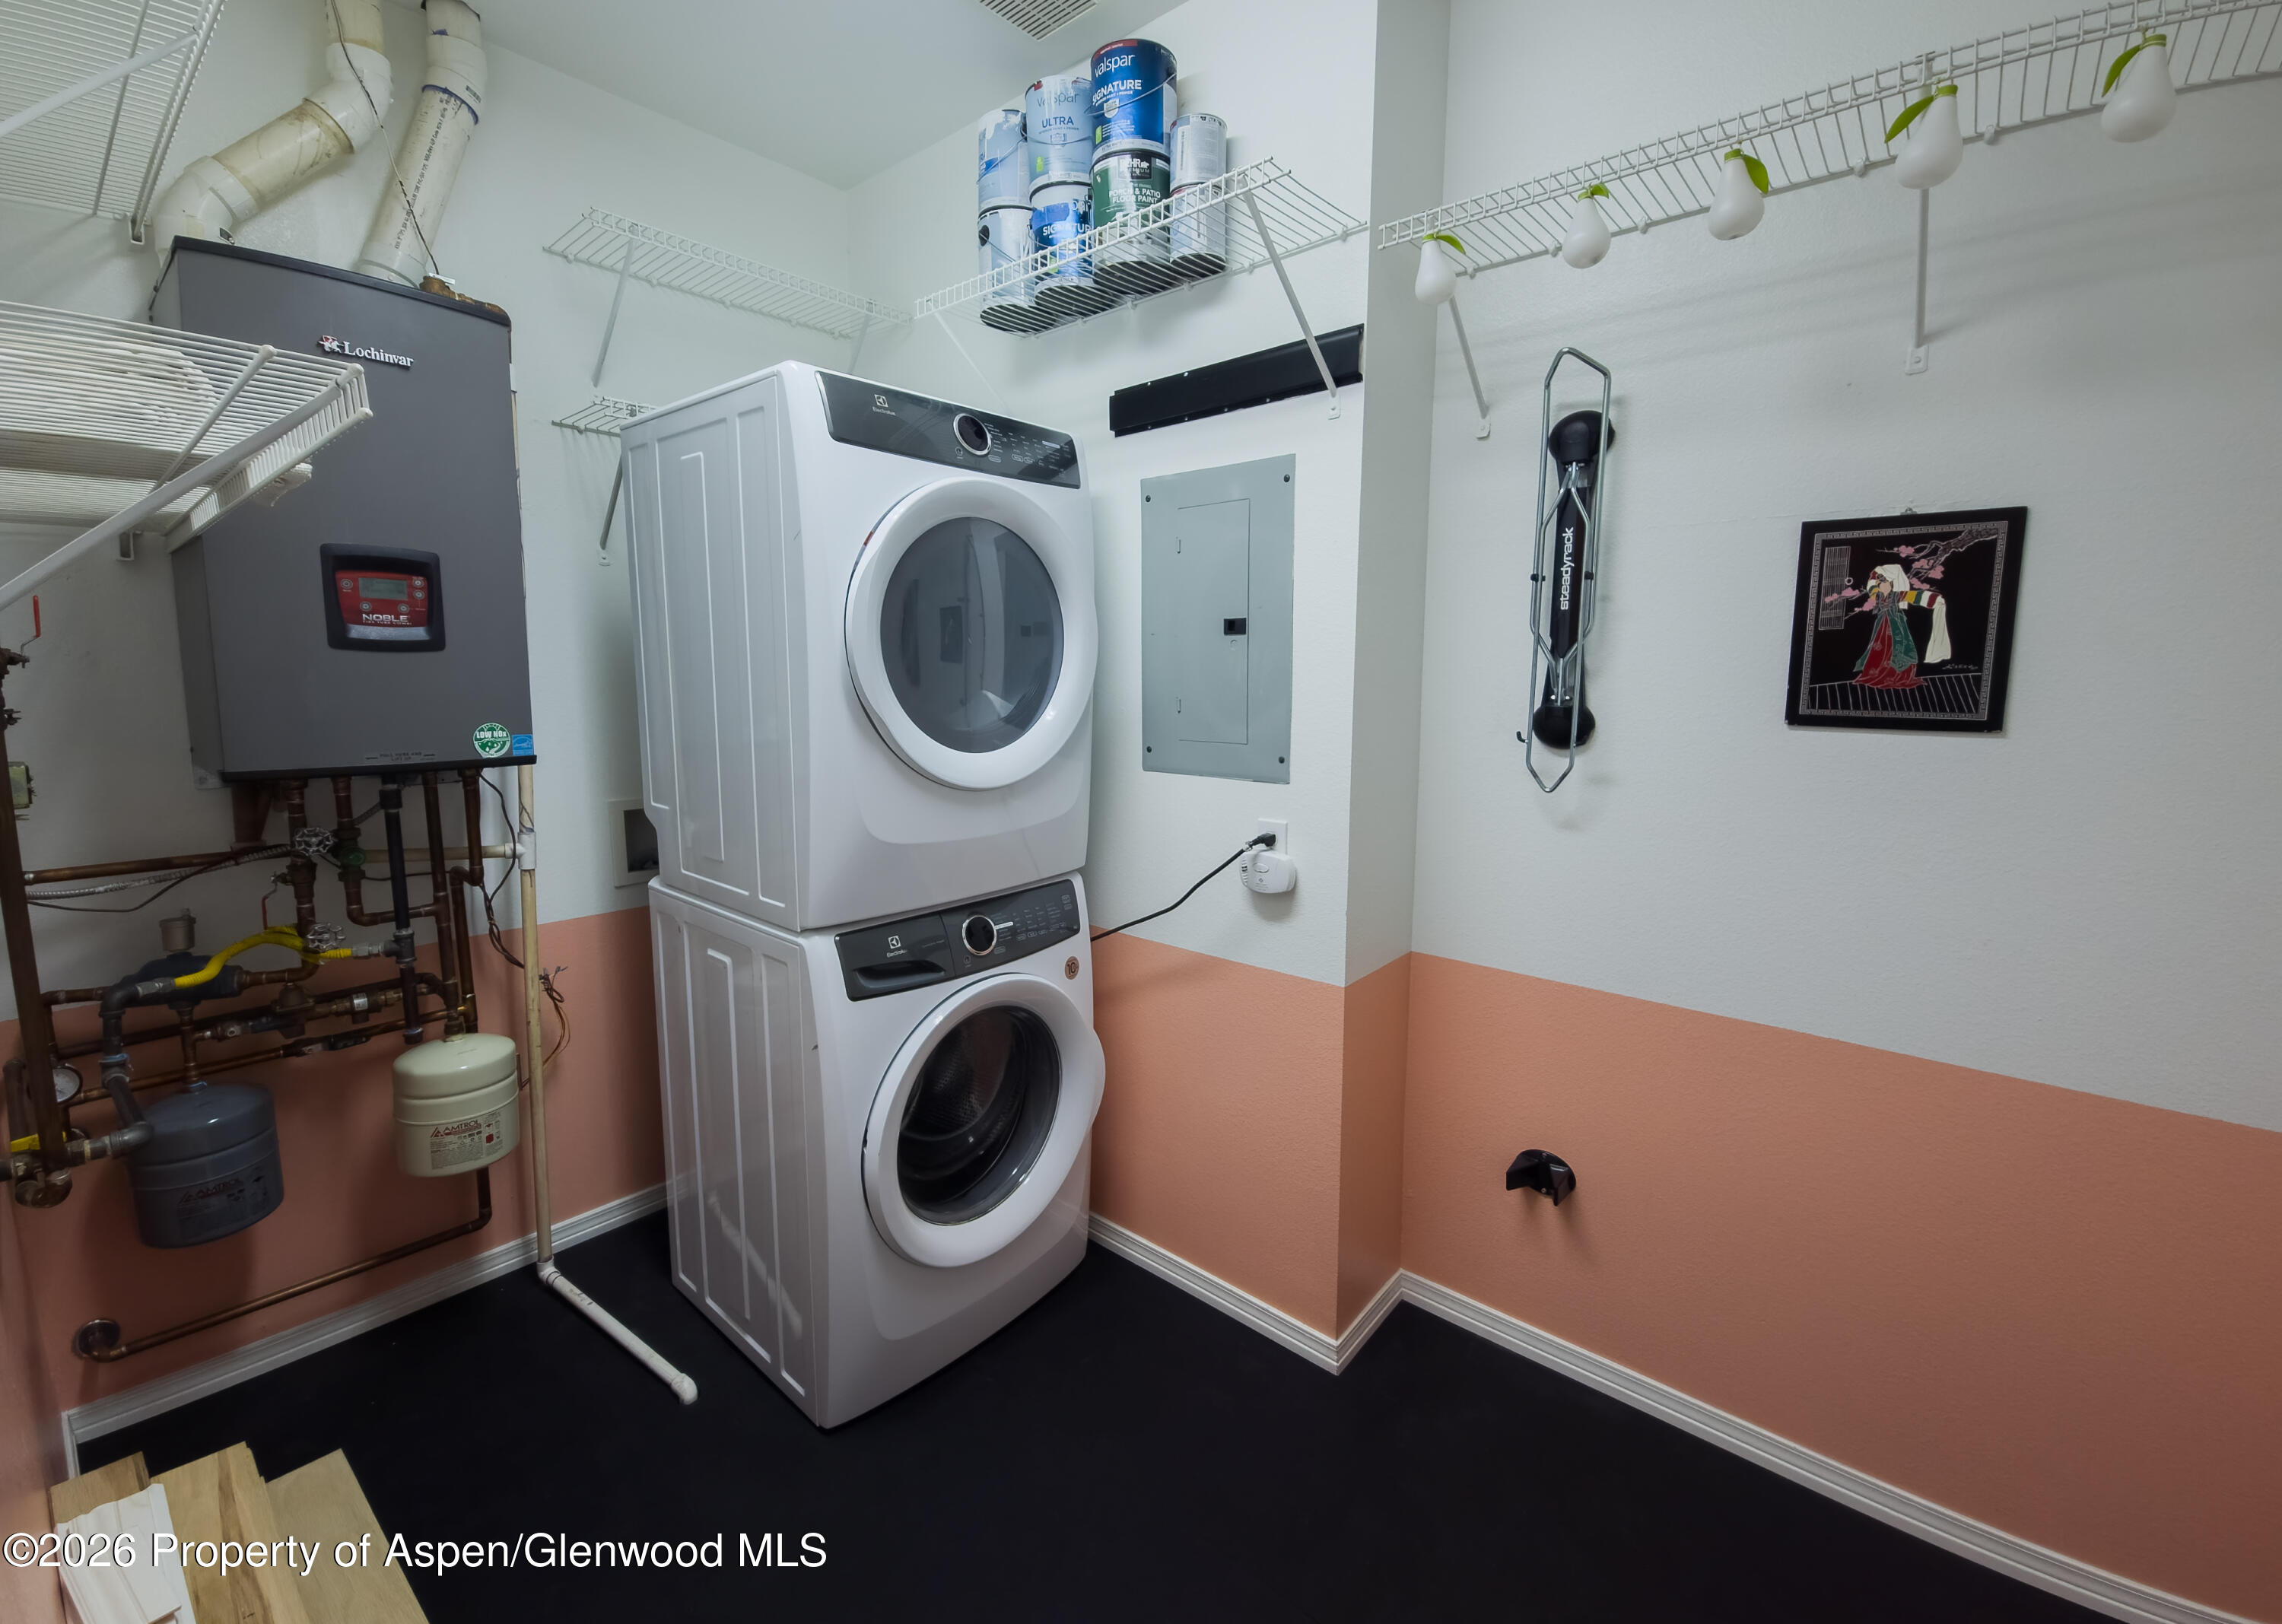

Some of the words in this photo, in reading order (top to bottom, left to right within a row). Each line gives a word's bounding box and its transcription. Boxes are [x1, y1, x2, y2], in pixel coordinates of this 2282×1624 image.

[1095, 54, 1136, 78] valspar
[1092, 79, 1143, 106] SIGNATURE
[1041, 116, 1074, 128] ULTRA
[1112, 195, 1136, 204] FLOOR
[1138, 195, 1157, 204] PAINT
[1143, 188, 1161, 199] PATIO
[343, 341, 414, 367] Lochinvar
[1559, 526, 1575, 610] steadyrack
[362, 613, 408, 622] NOBLE
[443, 1120, 478, 1132] AMTROL
